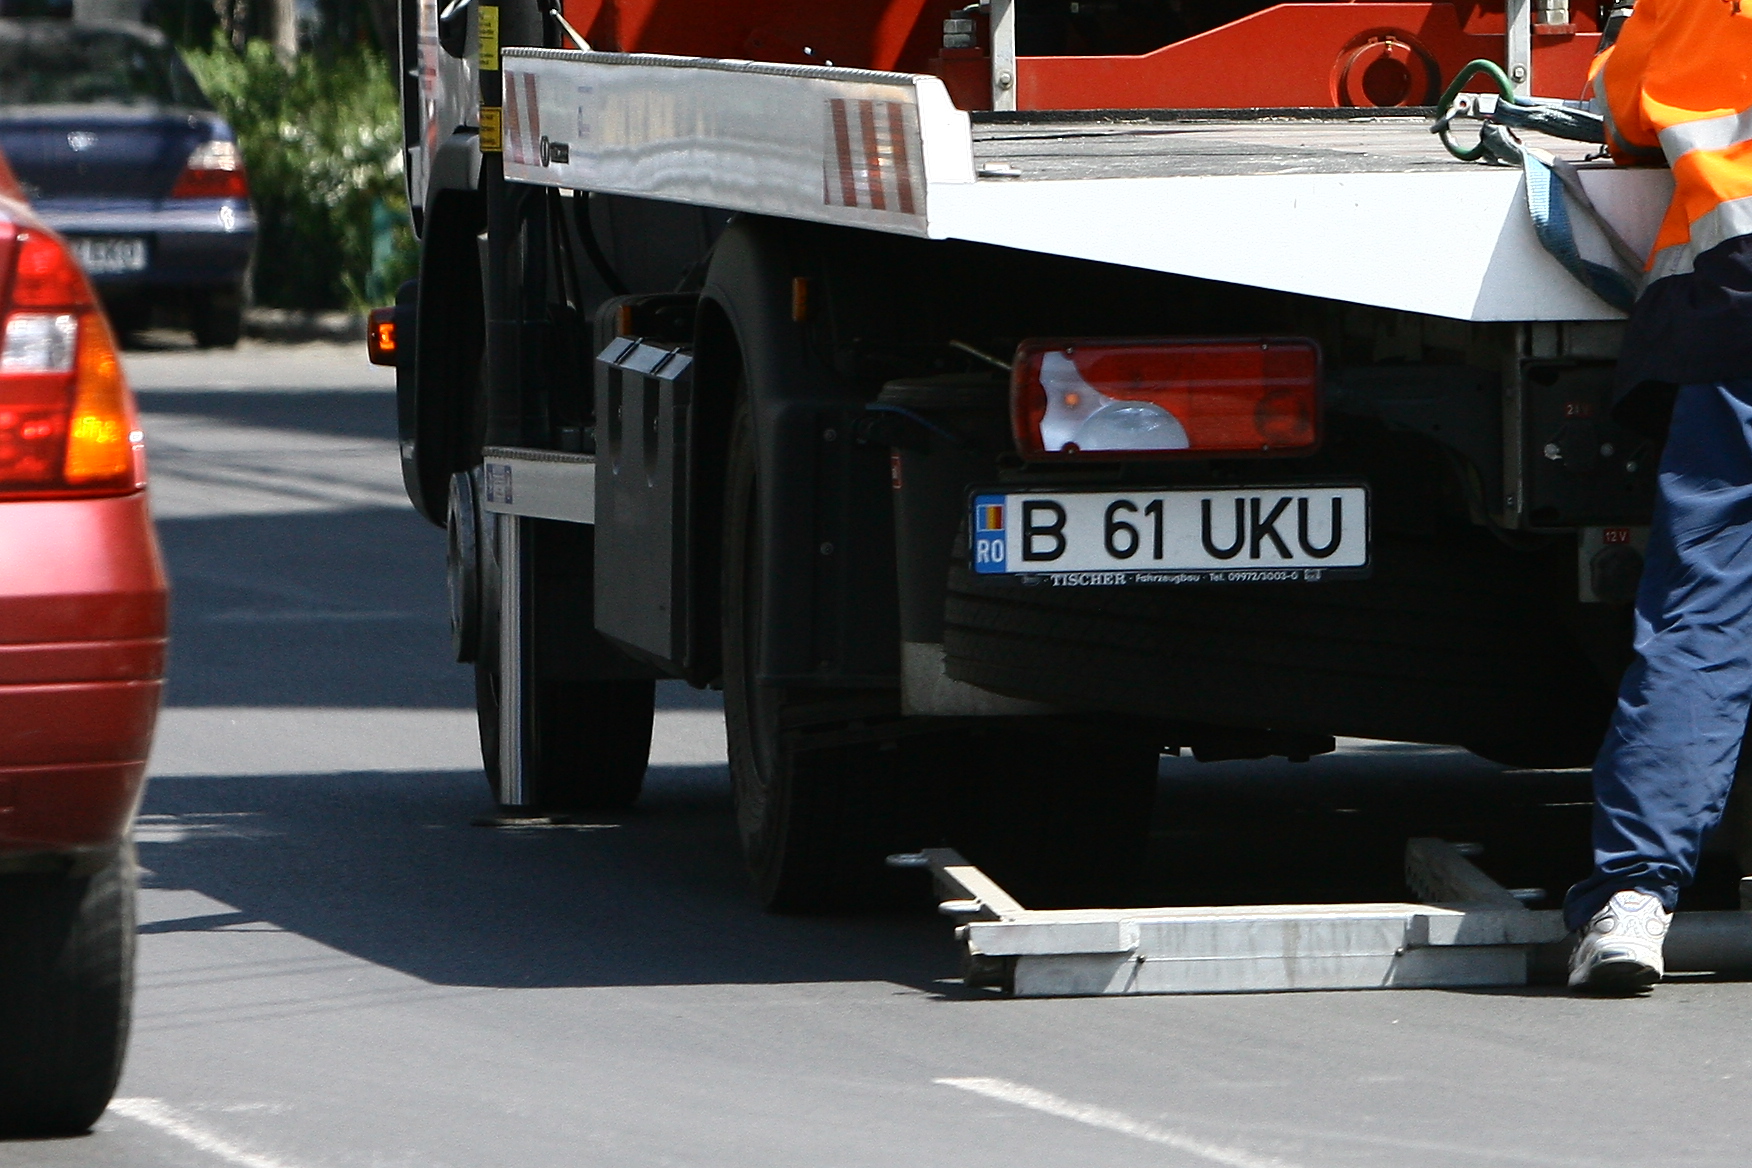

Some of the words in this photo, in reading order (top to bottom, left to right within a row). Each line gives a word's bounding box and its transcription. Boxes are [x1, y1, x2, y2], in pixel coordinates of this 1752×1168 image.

[1021, 500, 1067, 562] B
[1104, 499, 1163, 560] 61
[1201, 497, 1343, 560] UKU
[976, 538, 1005, 563] RO
[1050, 573, 1127, 587] TISCHER
[1135, 572, 1201, 585] Fahrzeugbau
[1209, 571, 1225, 582] Tel.
